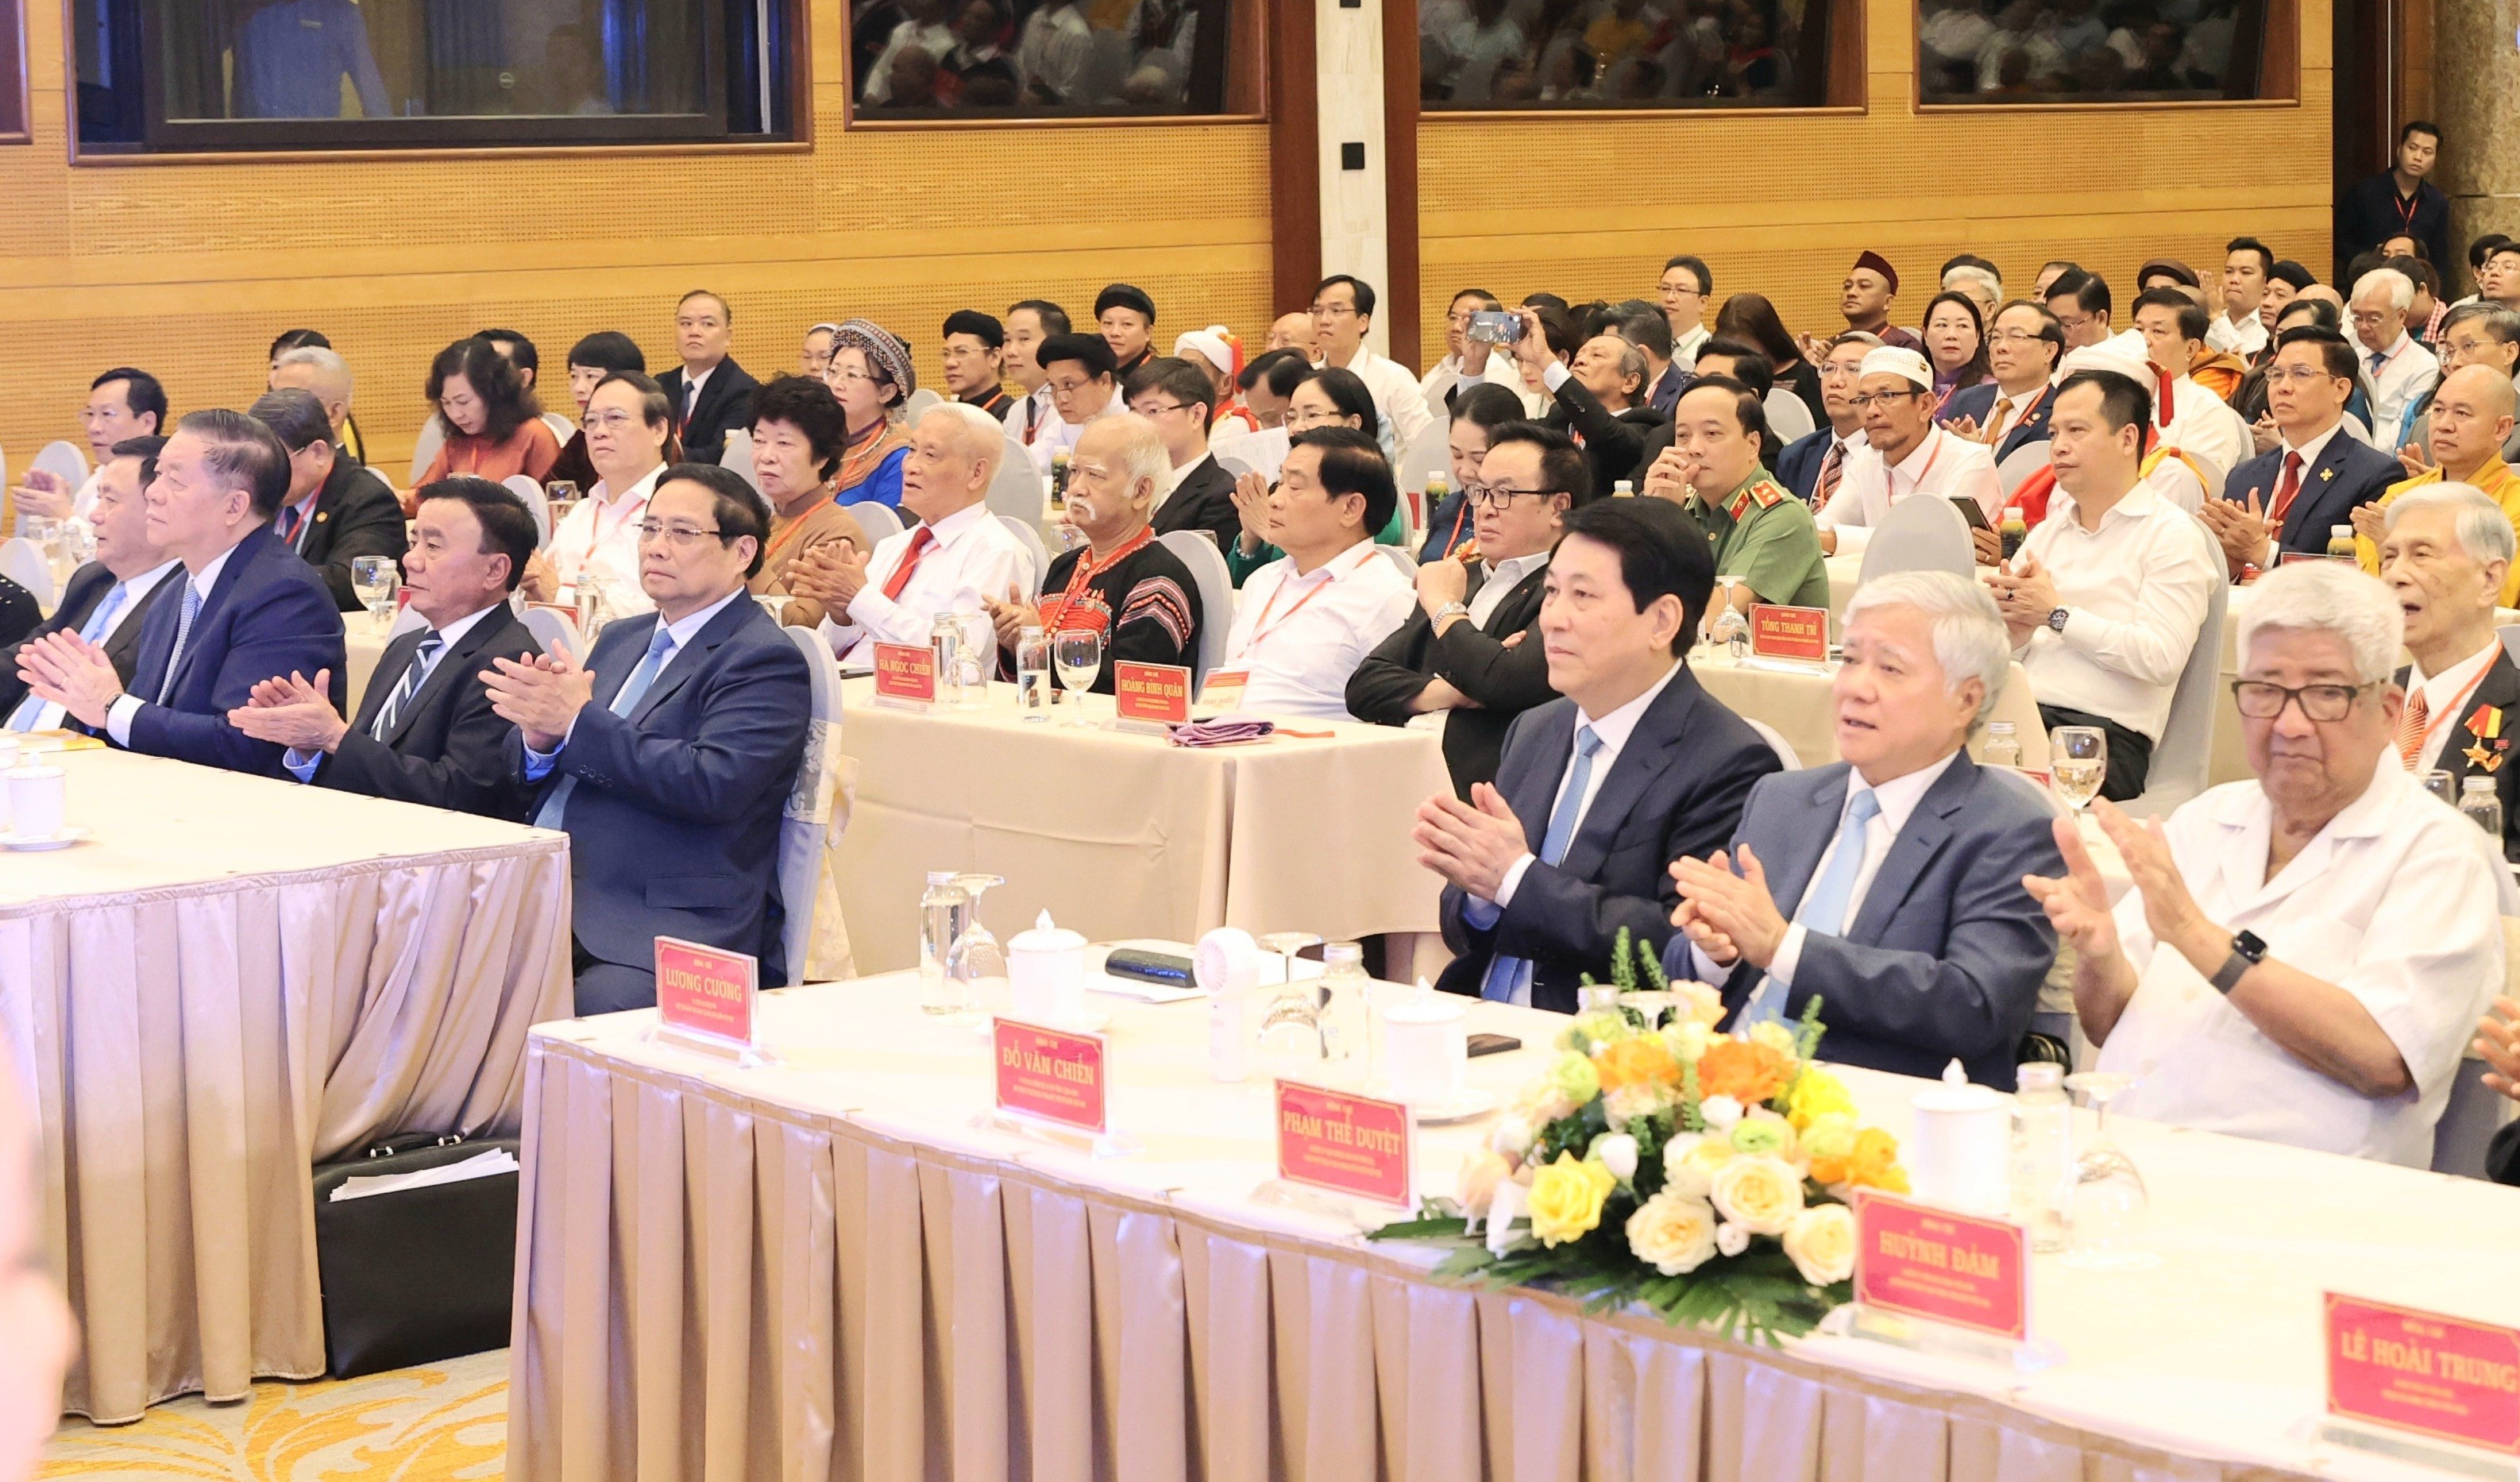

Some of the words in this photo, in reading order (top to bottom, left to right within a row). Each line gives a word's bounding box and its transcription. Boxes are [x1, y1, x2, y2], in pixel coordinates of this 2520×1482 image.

[1781, 623, 1804, 635] THANH
[1121, 676, 1144, 693] HOÀNG
[1023, 1050, 1052, 1076] VĂN
[1054, 1052, 1094, 1086] CHIẾN
[1283, 1110, 1322, 1140] PHẠM
[1356, 1128, 1401, 1158] DUYỆT
[1879, 1229, 1948, 1269] HUỲNH
[2341, 1326, 2368, 1363] LÊ
[2372, 1337, 2433, 1376] HOÀI
[2436, 1351, 2518, 1394] TRUNG
